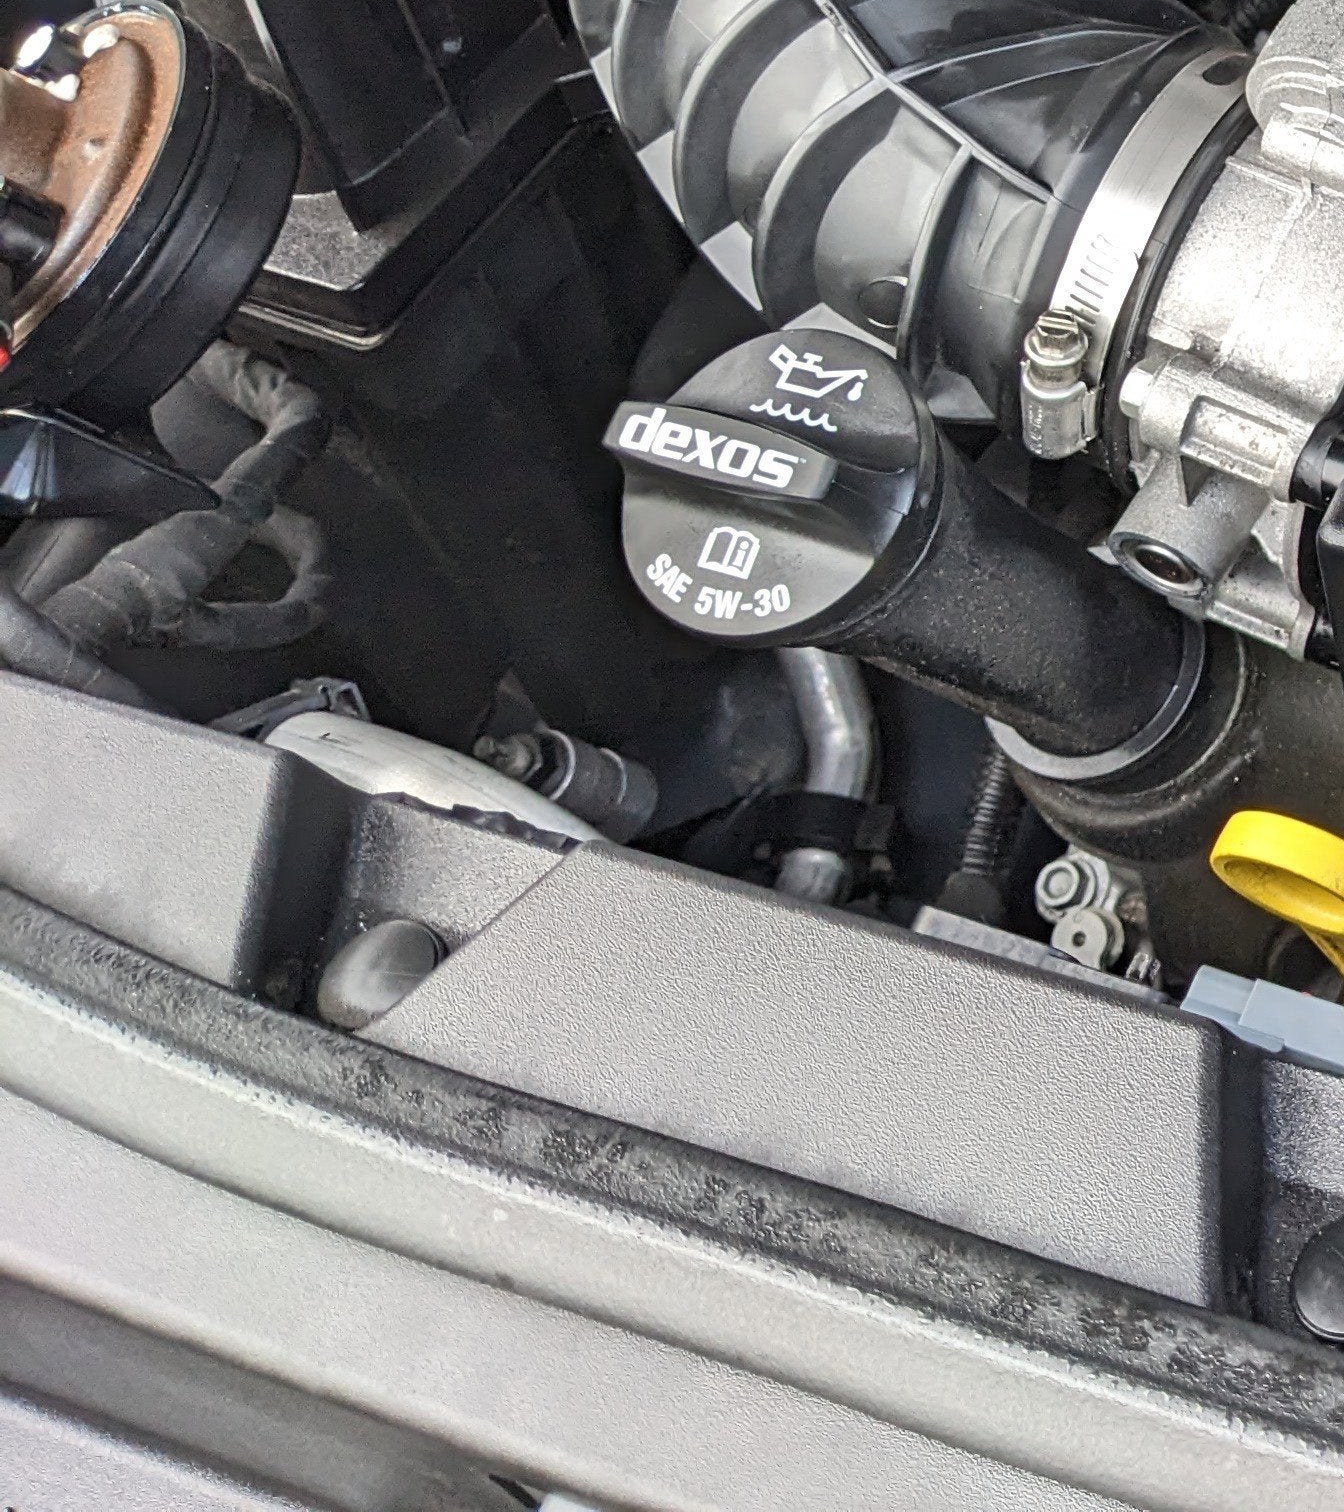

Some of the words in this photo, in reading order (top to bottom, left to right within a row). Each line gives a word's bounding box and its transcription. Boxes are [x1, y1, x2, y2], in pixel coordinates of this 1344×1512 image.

[619, 407, 799, 488] dexos
[646, 553, 693, 603] SAE
[694, 584, 791, 619] 5W-30
